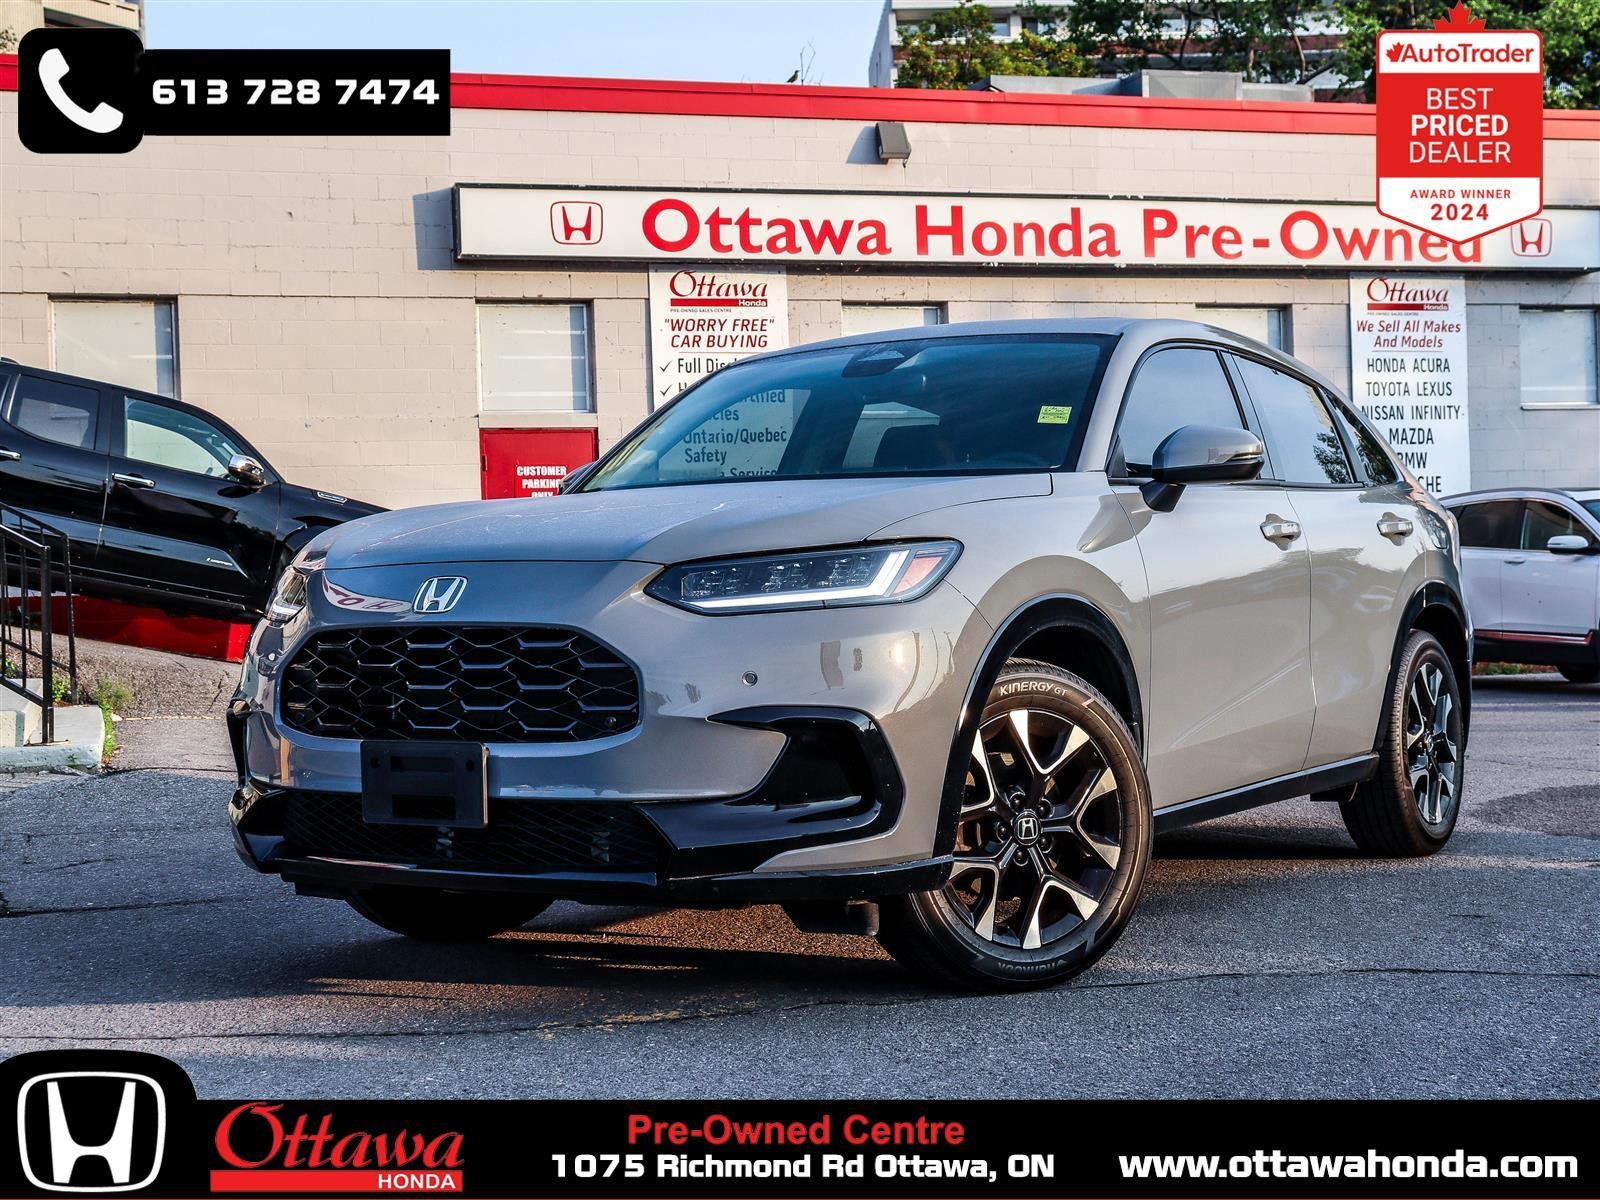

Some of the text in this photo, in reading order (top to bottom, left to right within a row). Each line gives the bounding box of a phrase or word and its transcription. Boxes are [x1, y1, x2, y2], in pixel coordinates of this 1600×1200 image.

[642, 198, 892, 254] Ottawa
[915, 204, 1121, 258] Honda
[669, 270, 768, 297] Ottawa
[1367, 277, 1449, 302] Ottawa
[738, 299, 767, 307] Honda
[665, 318, 775, 332] "WORRY FREE"
[1356, 319, 1461, 334] We Sell All Makes
[671, 334, 768, 348] CAR BUYING
[1374, 335, 1443, 348] And Models
[678, 357, 701, 374] Full
[1367, 358, 1450, 373] HONDA ACURA
[1366, 381, 1452, 396] TOYOTA LEXUS
[1361, 405, 1460, 420] NISSAN INFINITY
[683, 427, 787, 444] Ontario/Quebec
[1389, 428, 1434, 445] MAZDA
[684, 447, 727, 465] Safety
[516, 465, 567, 476] CUSTOMER
